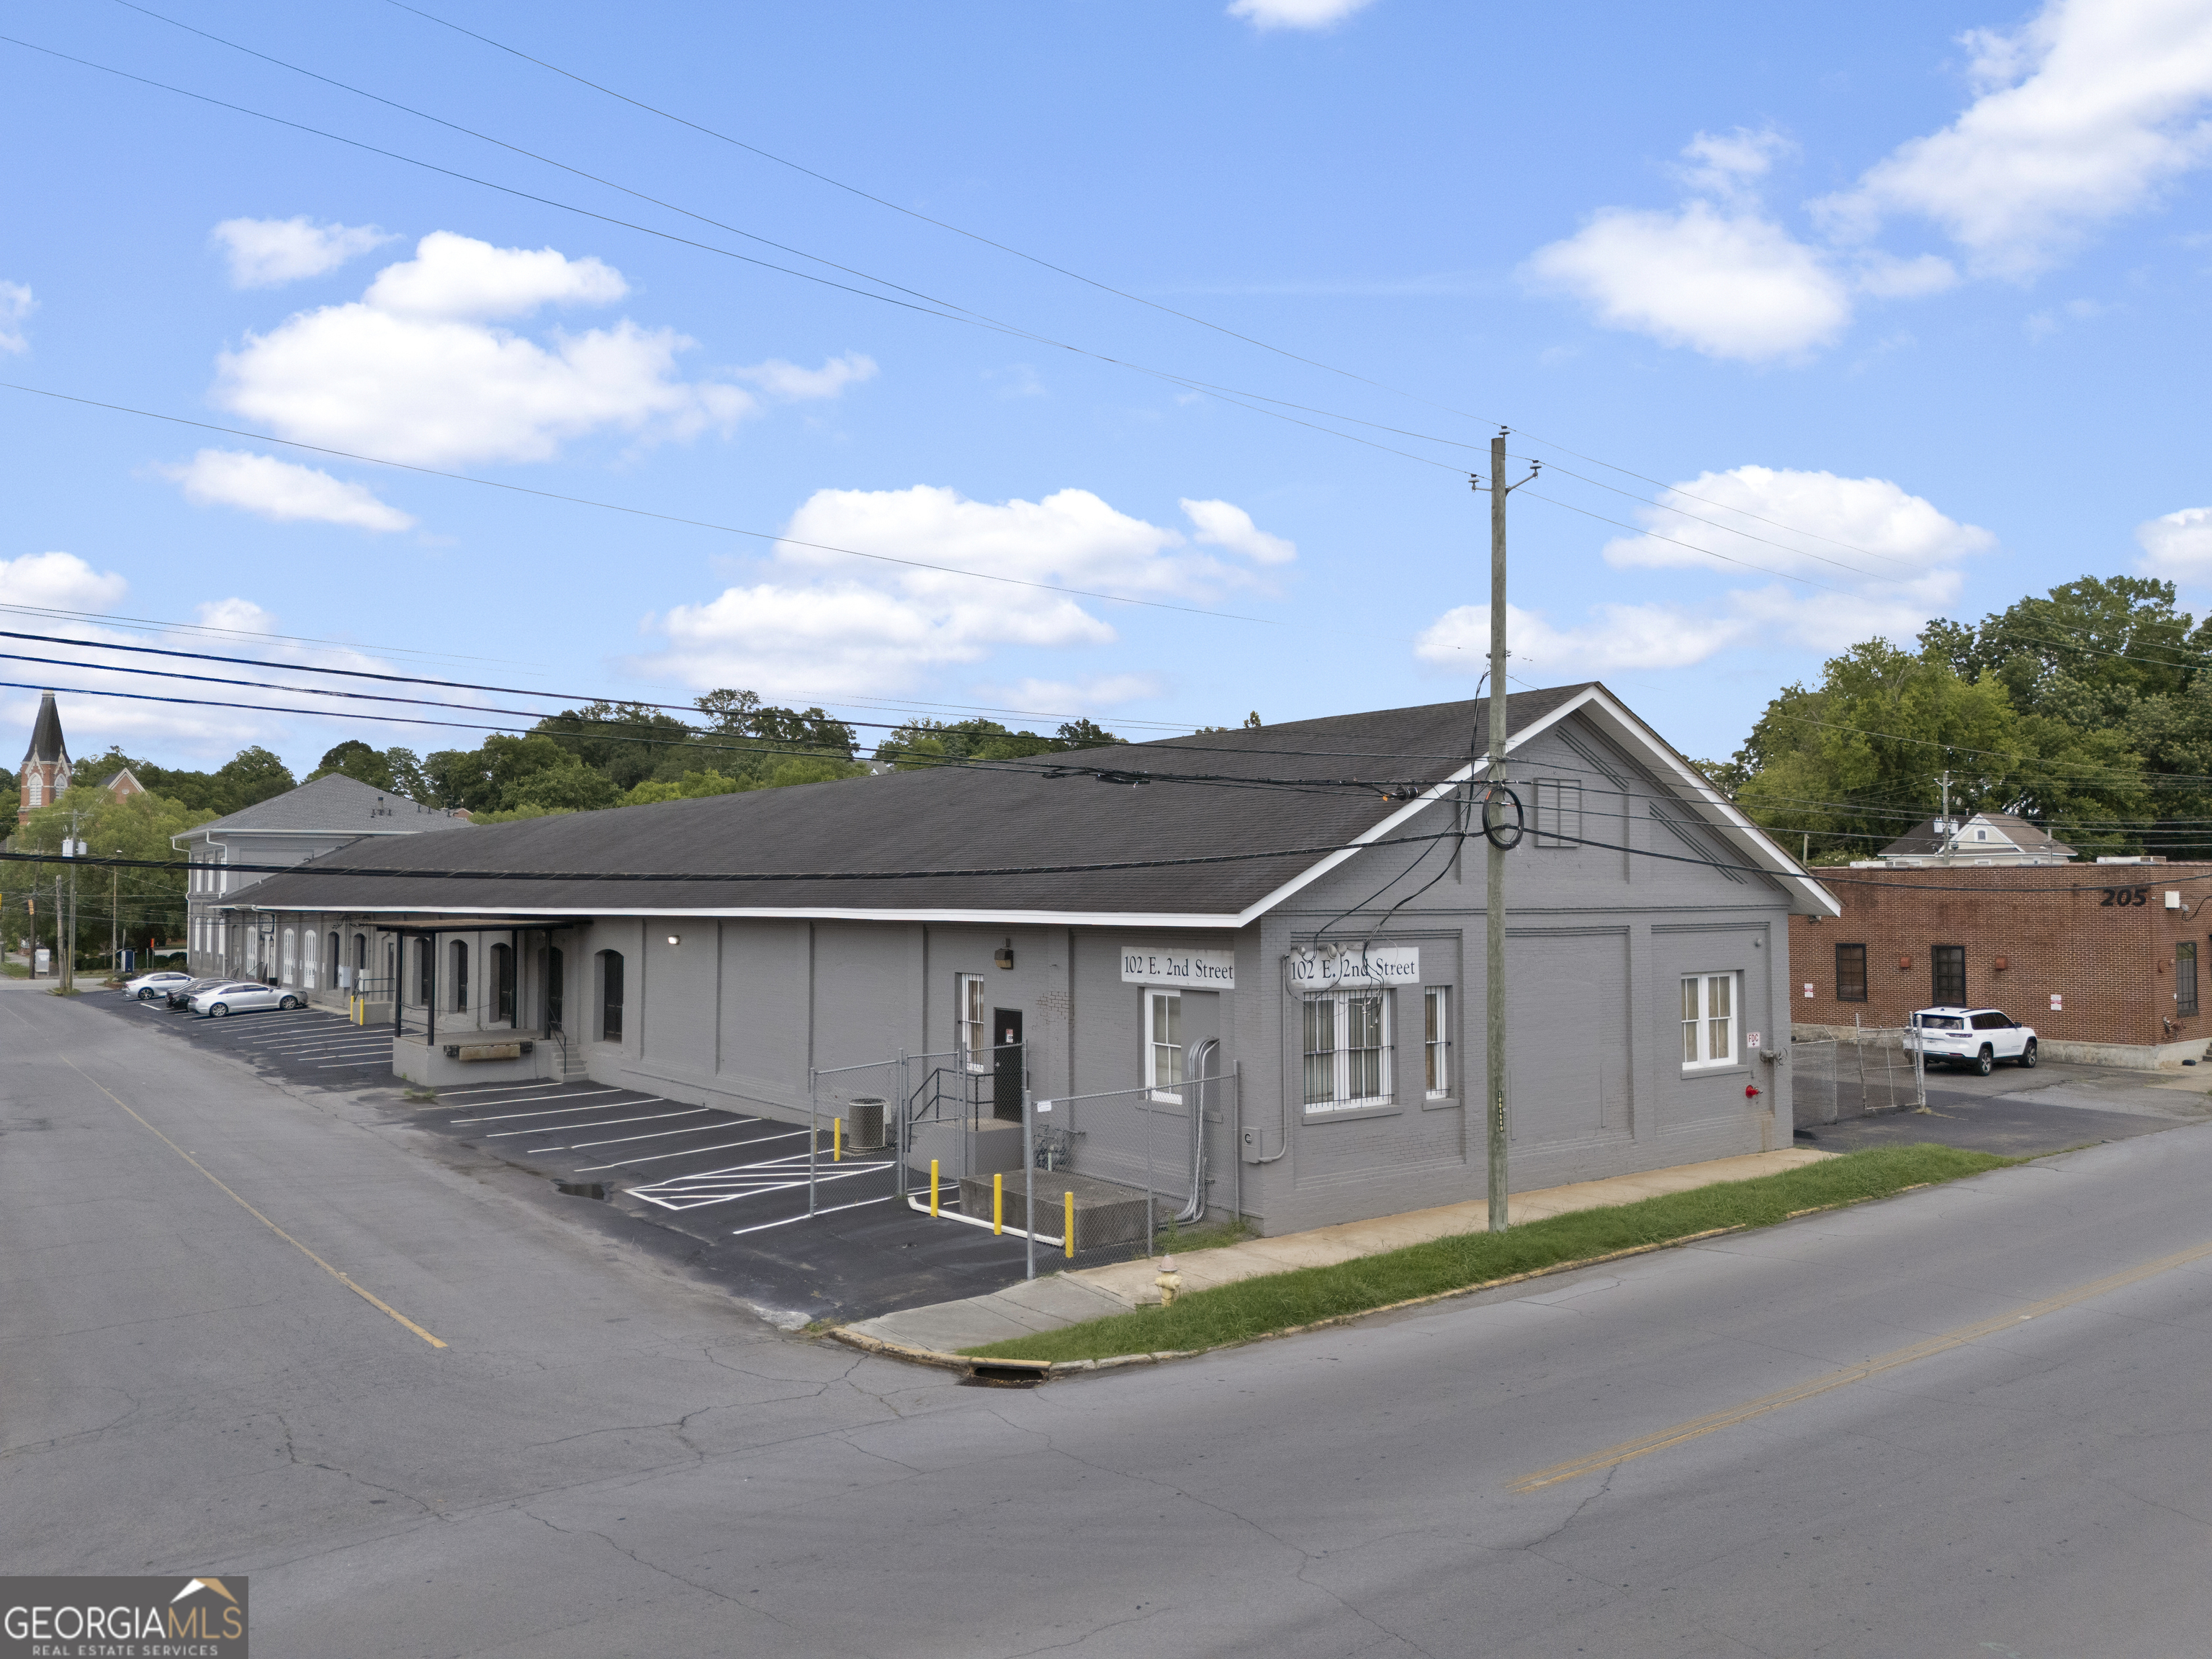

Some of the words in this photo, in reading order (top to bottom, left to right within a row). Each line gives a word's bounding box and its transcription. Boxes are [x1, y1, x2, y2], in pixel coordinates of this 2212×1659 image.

[2100, 889, 2146, 906] 205
[1125, 956, 1143, 974] 102
[1148, 956, 1161, 975] E.
[1166, 958, 1190, 976] 2nd
[1195, 959, 1233, 979] Street
[1291, 961, 1315, 980] 102
[1321, 960, 1336, 979] E.
[1343, 958, 1369, 977] 2nd
[1376, 958, 1415, 976] Street
[1748, 1033, 1759, 1043] FDC
